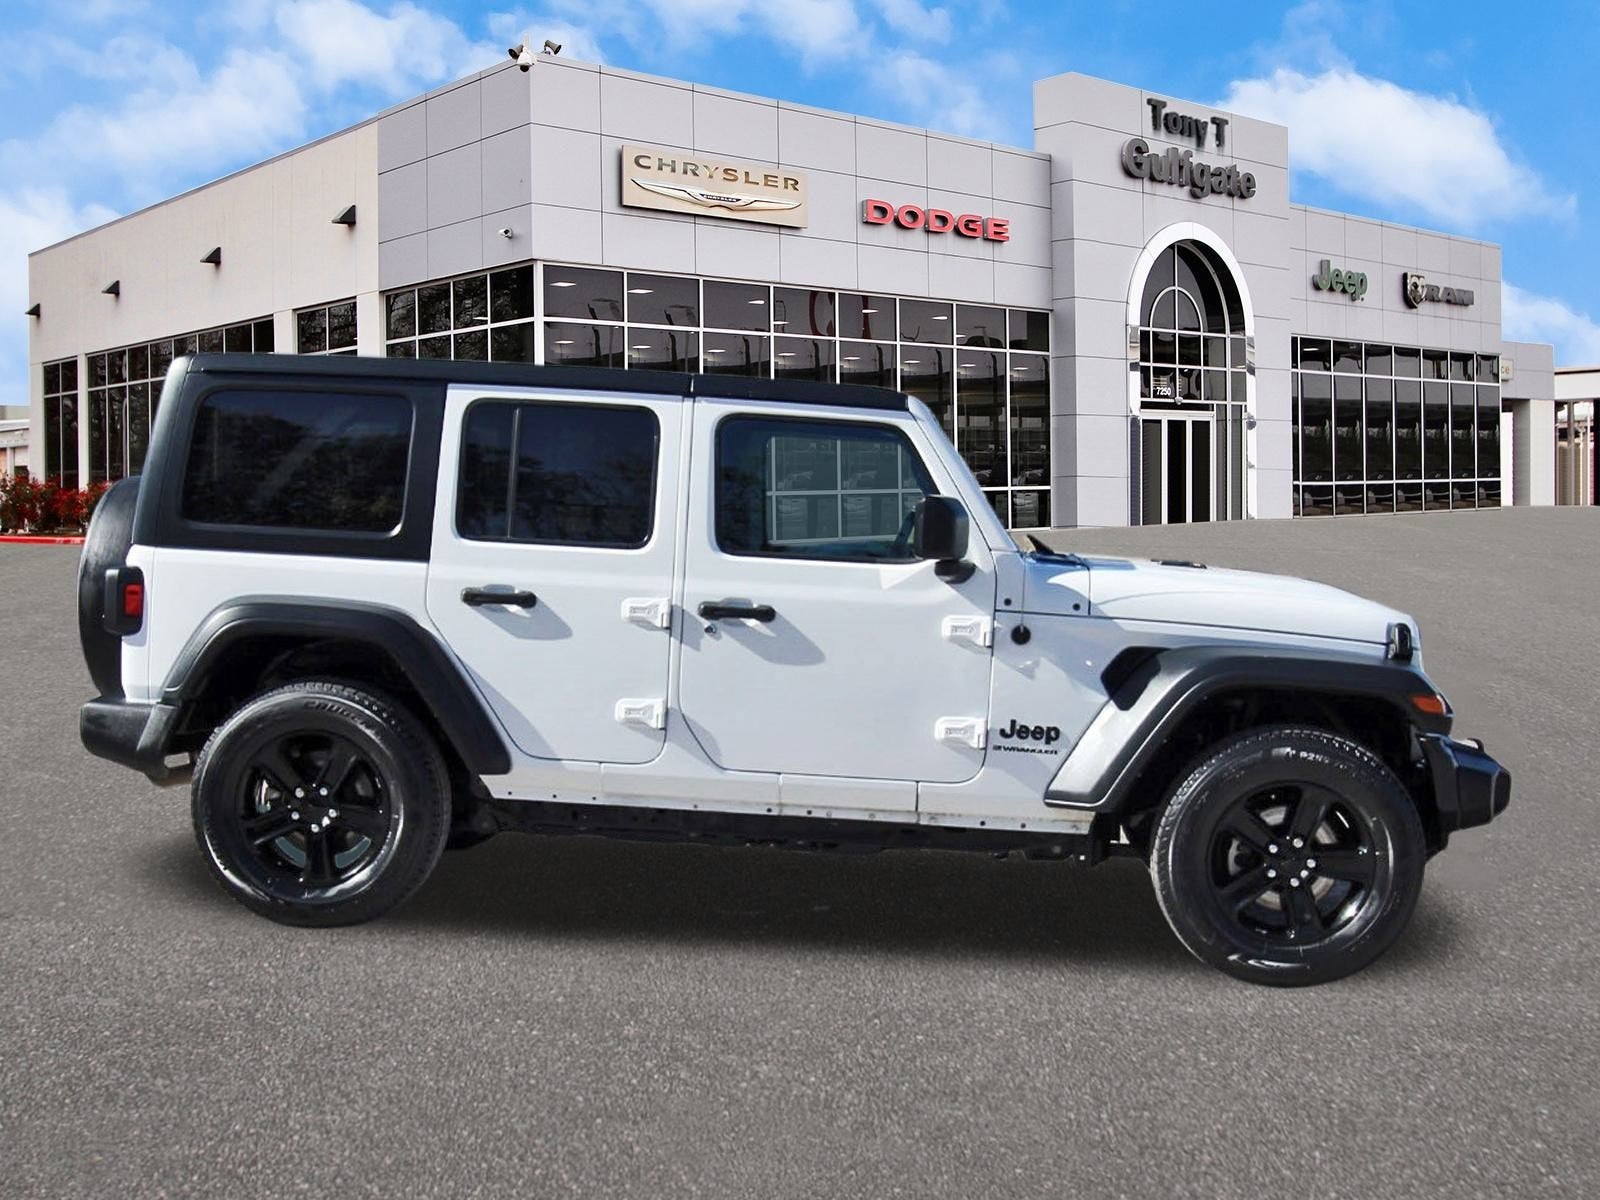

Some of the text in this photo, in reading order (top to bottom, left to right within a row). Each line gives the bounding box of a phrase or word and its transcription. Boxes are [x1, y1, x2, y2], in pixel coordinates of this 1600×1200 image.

[1146, 98, 1229, 147] Tony T
[634, 154, 800, 191] CHRYSLER
[1121, 138, 1256, 199] Gulfgate
[863, 198, 1010, 242] DODGE
[1312, 259, 1368, 302] Jeep
[1425, 284, 1474, 306] RAM
[1156, 387, 1171, 396] 7250
[999, 719, 1060, 745] Jeep
